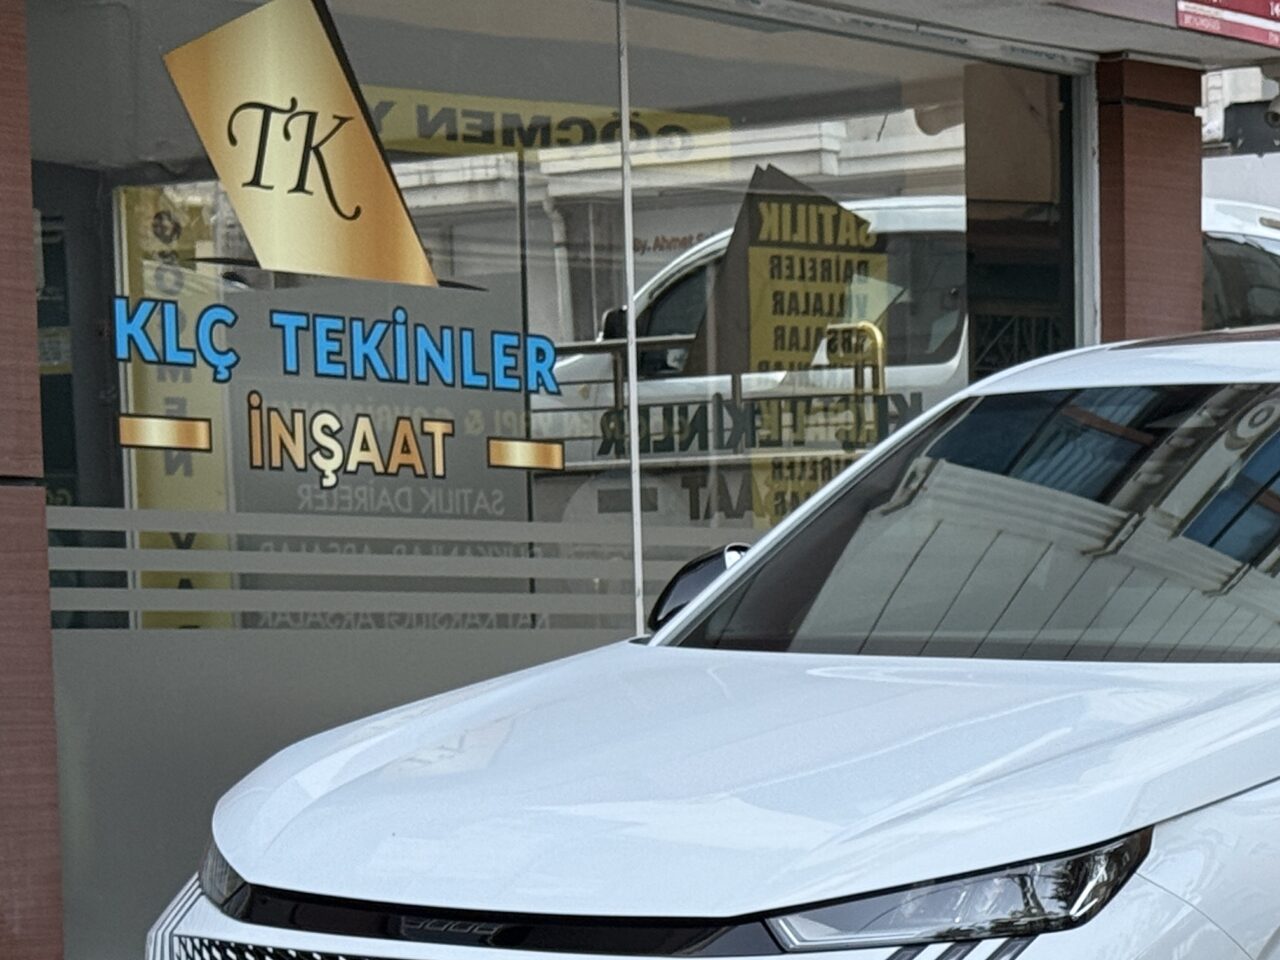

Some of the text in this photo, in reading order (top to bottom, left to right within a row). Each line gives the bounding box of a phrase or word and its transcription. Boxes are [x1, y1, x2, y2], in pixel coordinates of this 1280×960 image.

[227, 97, 361, 220] TK
[114, 296, 561, 395] KLÇ TEKİNLER
[247, 390, 454, 488] İNŞAAT
